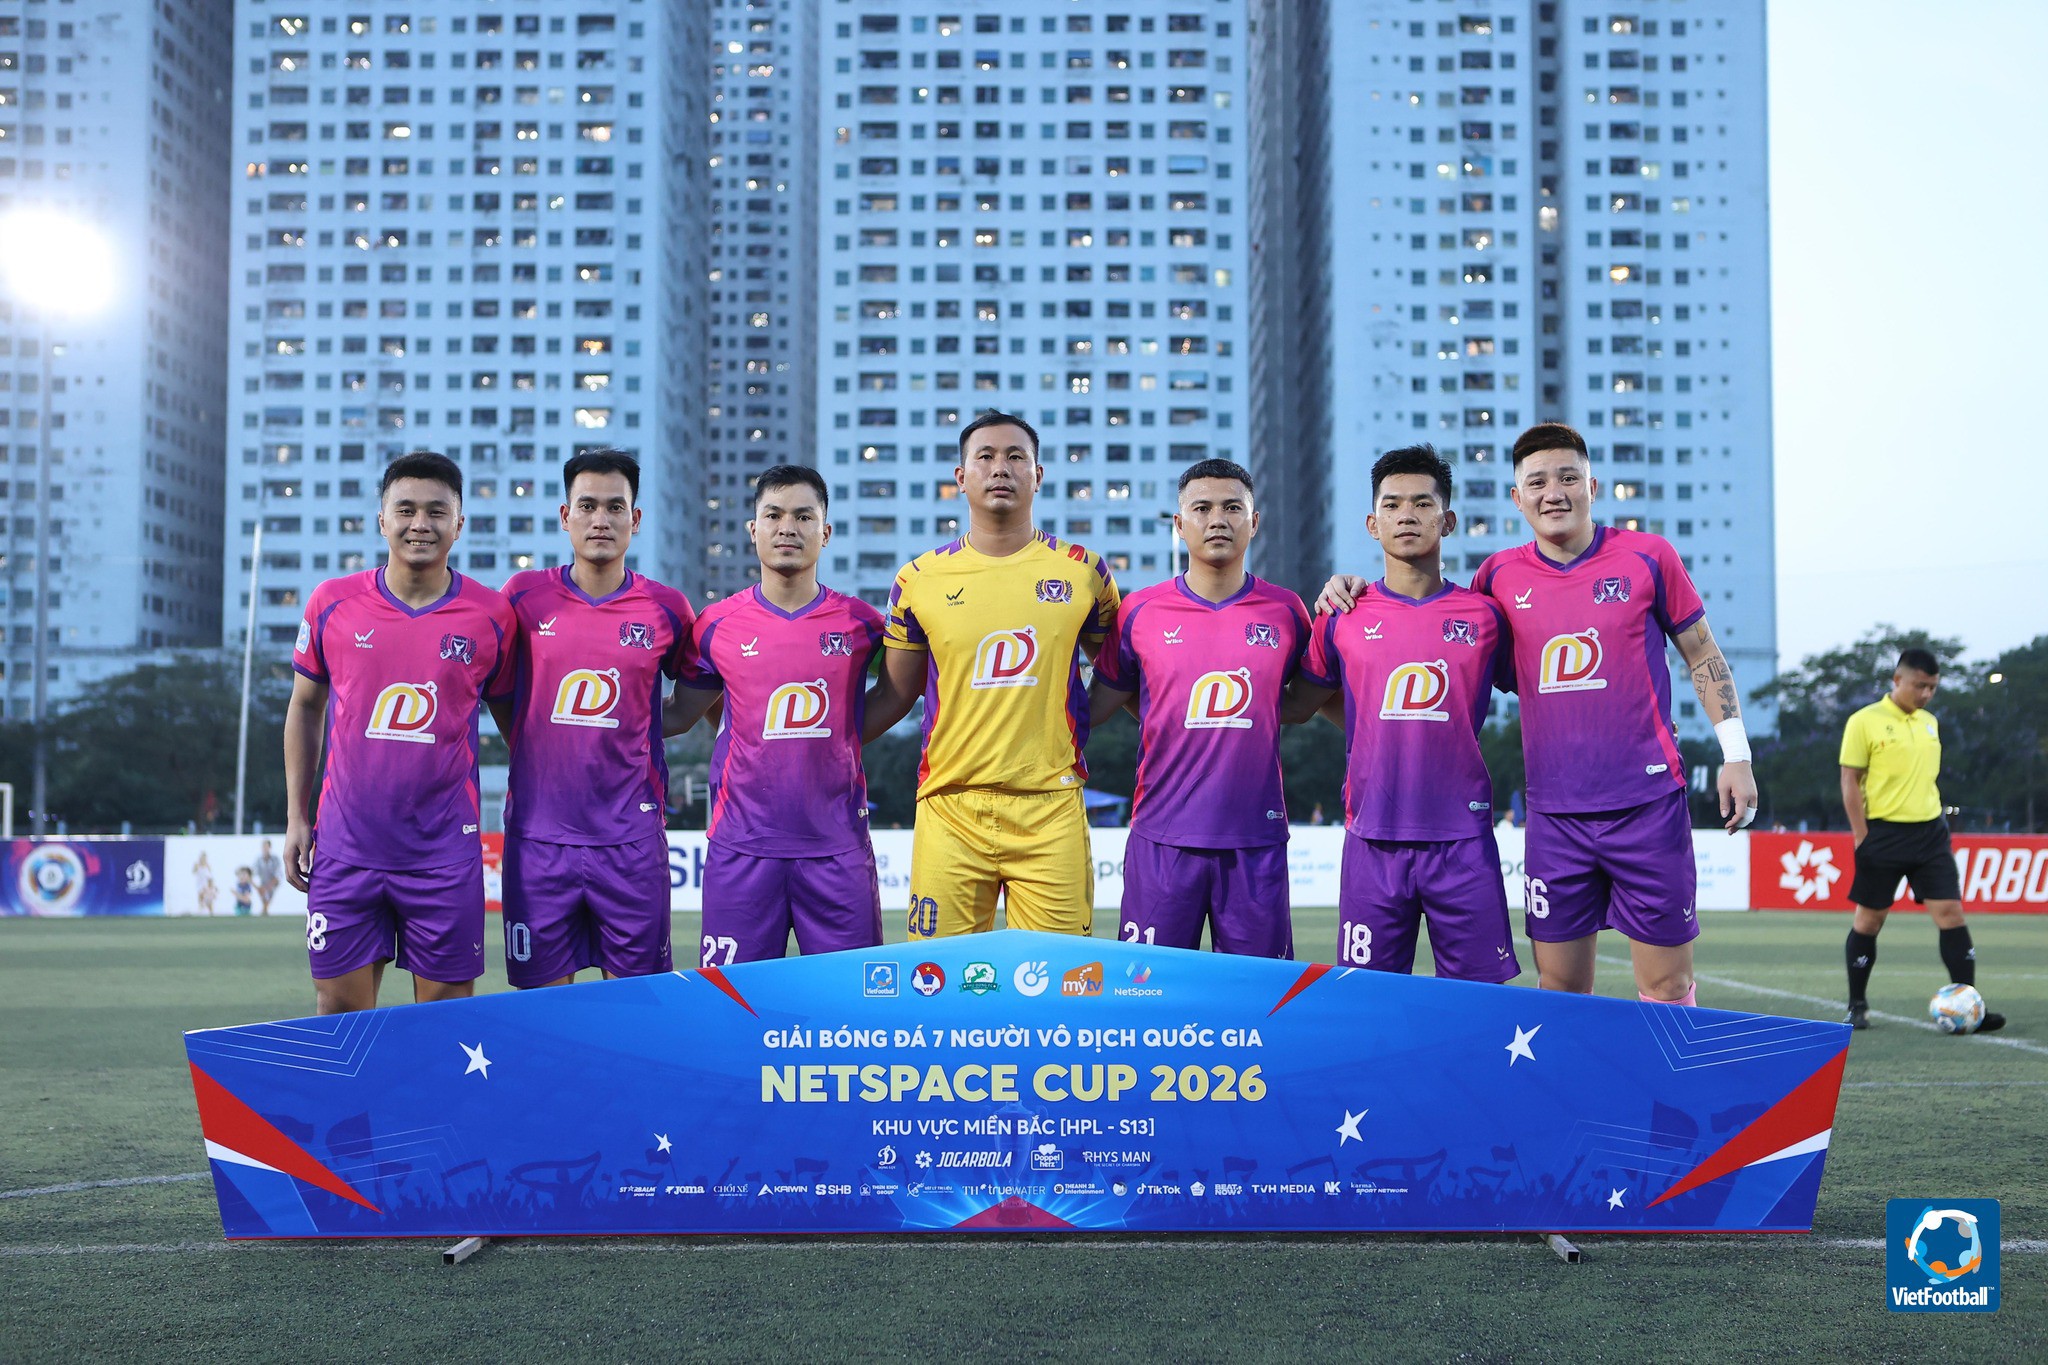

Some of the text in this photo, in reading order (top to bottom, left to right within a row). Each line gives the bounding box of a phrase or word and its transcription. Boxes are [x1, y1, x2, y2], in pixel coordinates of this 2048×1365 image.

[909, 893, 938, 938] 20
[505, 920, 532, 962] 10
[1342, 920, 1372, 966] 18
[702, 935, 739, 969] 27
[1063, 977, 1102, 996] mytv
[1114, 988, 1162, 997] NetSpace
[763, 1023, 1263, 1053] GIẢI BÓNG ĐÁ 7 NGƯỜI VÔ ĐỊCH QUỐC GIA
[761, 1063, 1268, 1103] NETSPACE CUP 2026
[872, 1119, 912, 1136] KHU
[917, 1118, 959, 1140] VỰC
[964, 1114, 1012, 1135] MIỀN
[1017, 1114, 1056, 1135] BẮC
[1060, 1118, 1103, 1137] [HPL
[1119, 1118, 1155, 1137] S13]
[936, 1151, 1013, 1168] JOGARBOLA
[1034, 1153, 1060, 1162] Doppel
[1039, 1160, 1056, 1168] herz
[1084, 1151, 1151, 1163] RHYS MAN
[828, 1184, 852, 1195] SHB
[962, 1185, 1046, 1196] TH trueWATER
[1148, 1185, 1181, 1195] TikTok
[1251, 1184, 1316, 1193] TVH MEDIA
[1324, 1181, 1341, 1193] NK
